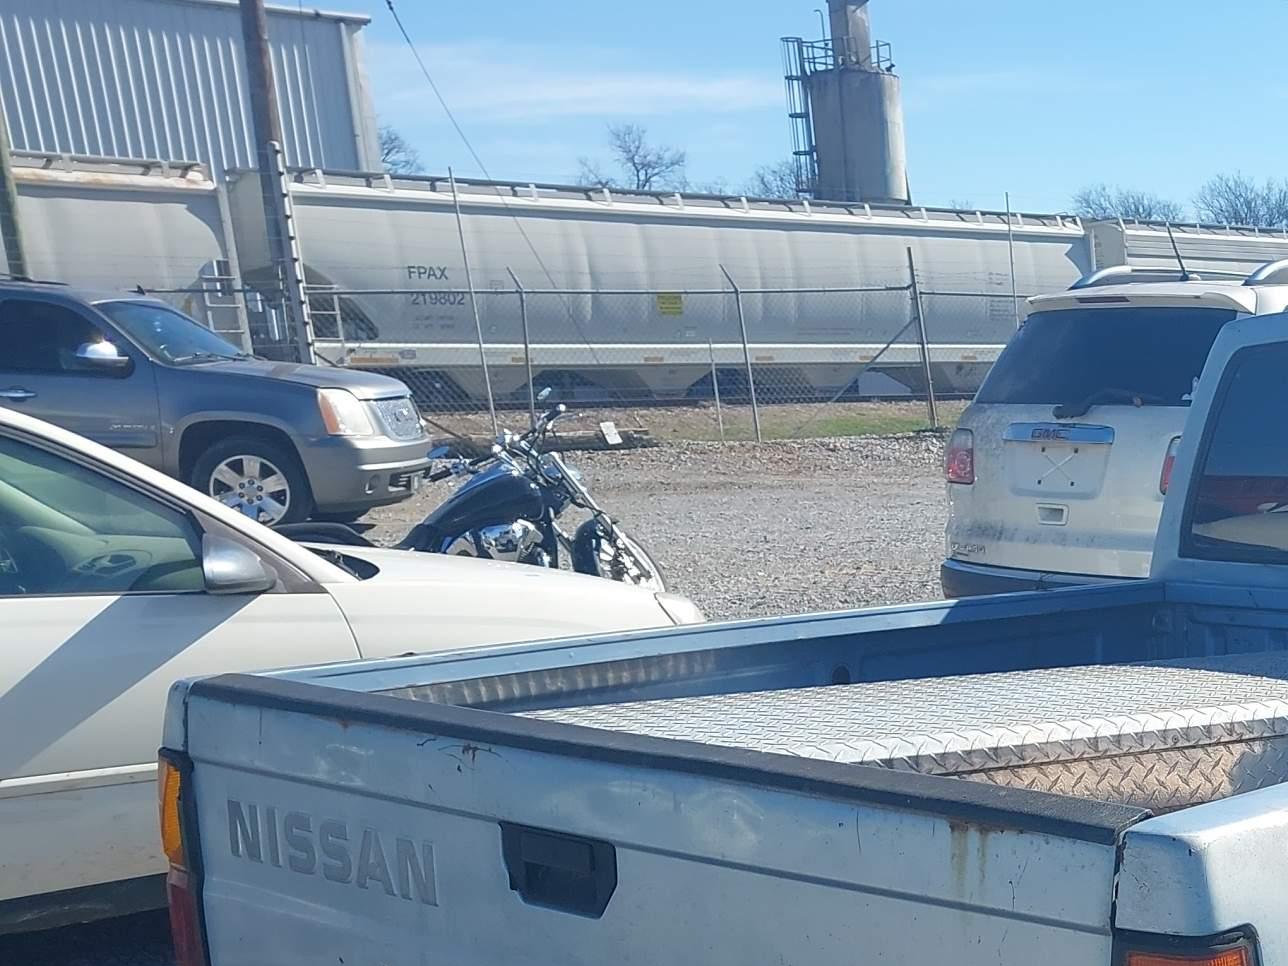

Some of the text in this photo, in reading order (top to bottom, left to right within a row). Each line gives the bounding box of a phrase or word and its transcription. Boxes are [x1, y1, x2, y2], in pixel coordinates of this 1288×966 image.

[407, 265, 449, 281] FPAX
[1031, 428, 1071, 441] GMC
[227, 799, 439, 907] NISSAN
